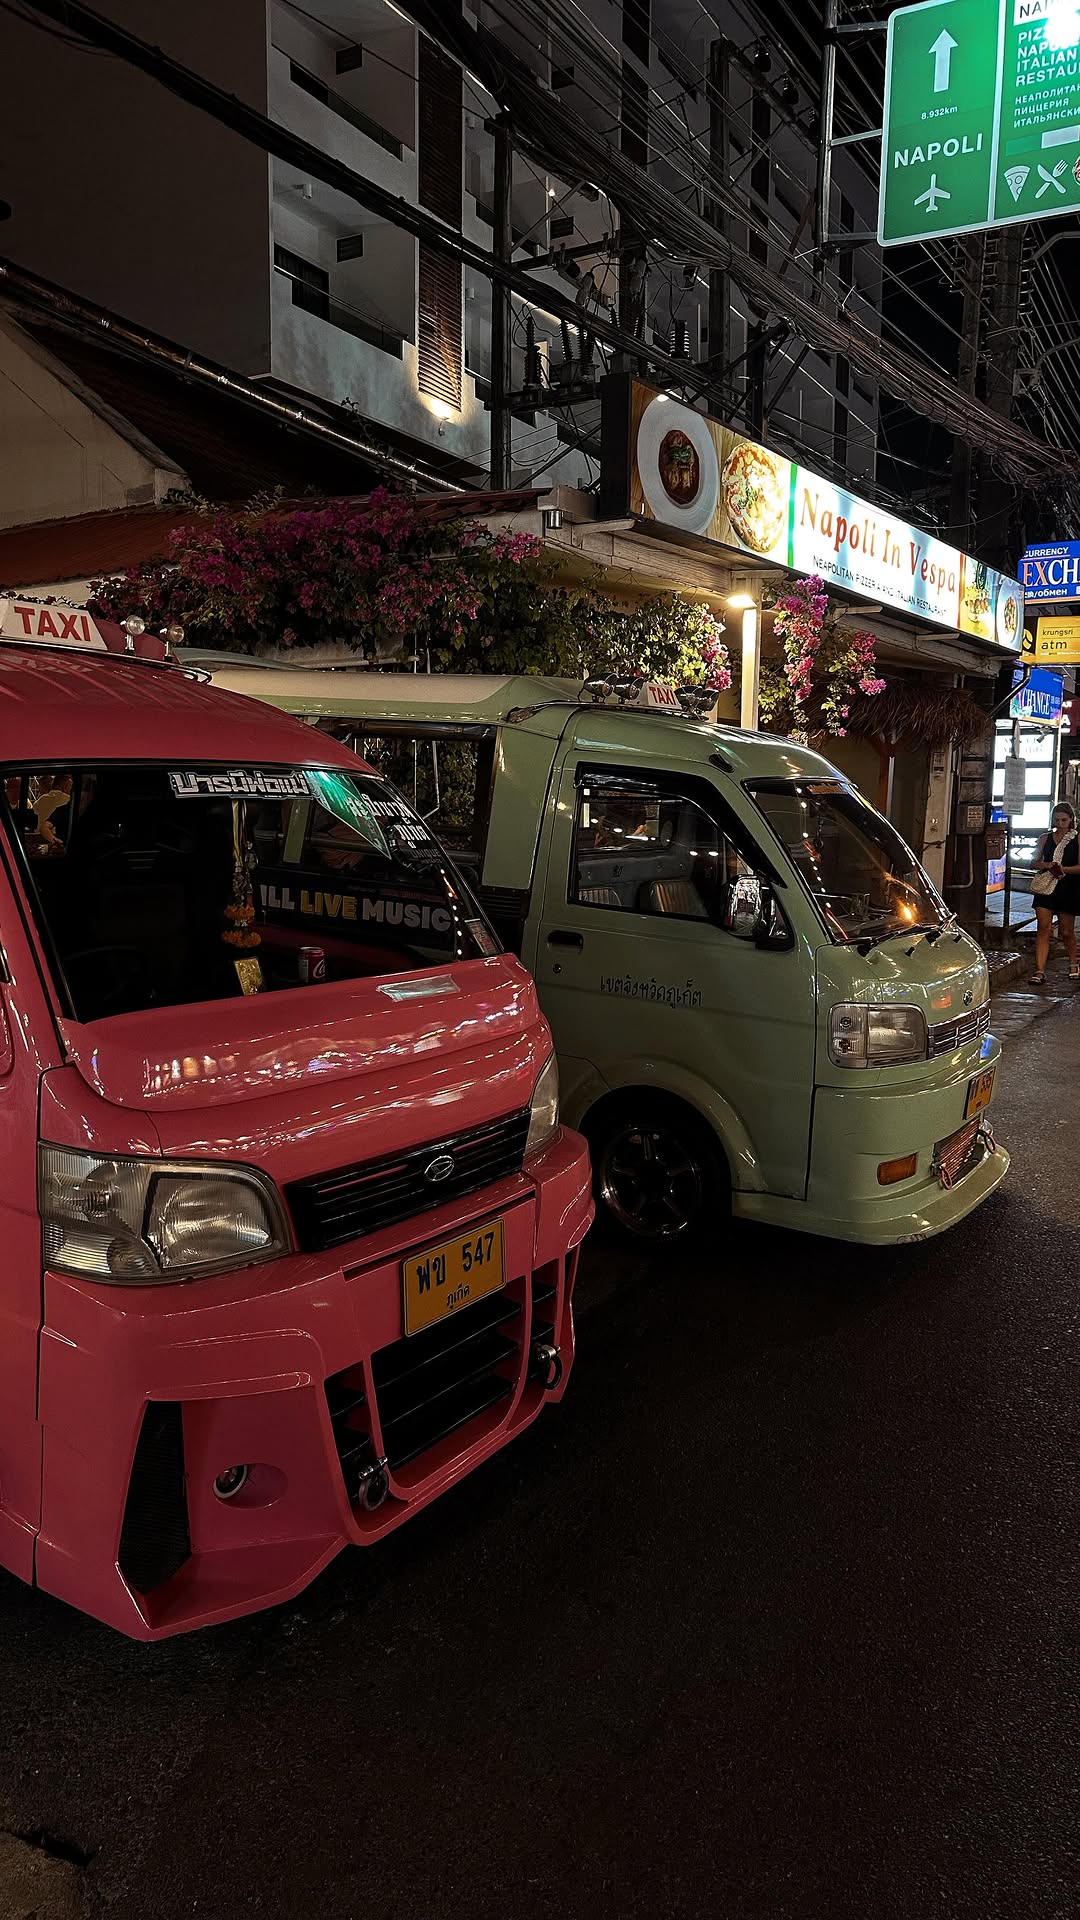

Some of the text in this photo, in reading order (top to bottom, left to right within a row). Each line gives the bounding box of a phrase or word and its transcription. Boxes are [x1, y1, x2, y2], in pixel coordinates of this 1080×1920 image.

[1016, 48, 1077, 73] ITALIAN
[1015, 62, 1080, 88] RESTAU
[920, 105, 958, 120] 8.932km
[1014, 97, 1070, 117] ПИЦЦЕРИЯ
[893, 132, 983, 169] NAPOLI
[800, 487, 956, 596] Napoli In Vespa
[1024, 546, 1069, 558] CURRENCY
[812, 555, 854, 581] NEAPOLITAN
[1022, 557, 1080, 588] EXCH
[13, 606, 91, 642] TAXI
[1042, 629, 1073, 637] krungsri
[1041, 640, 1068, 650] atm
[648, 686, 677, 706] TAXI
[301, 890, 357, 921] LIVE
[362, 898, 450, 932] MUSIC
[461, 1231, 494, 1272] 547
